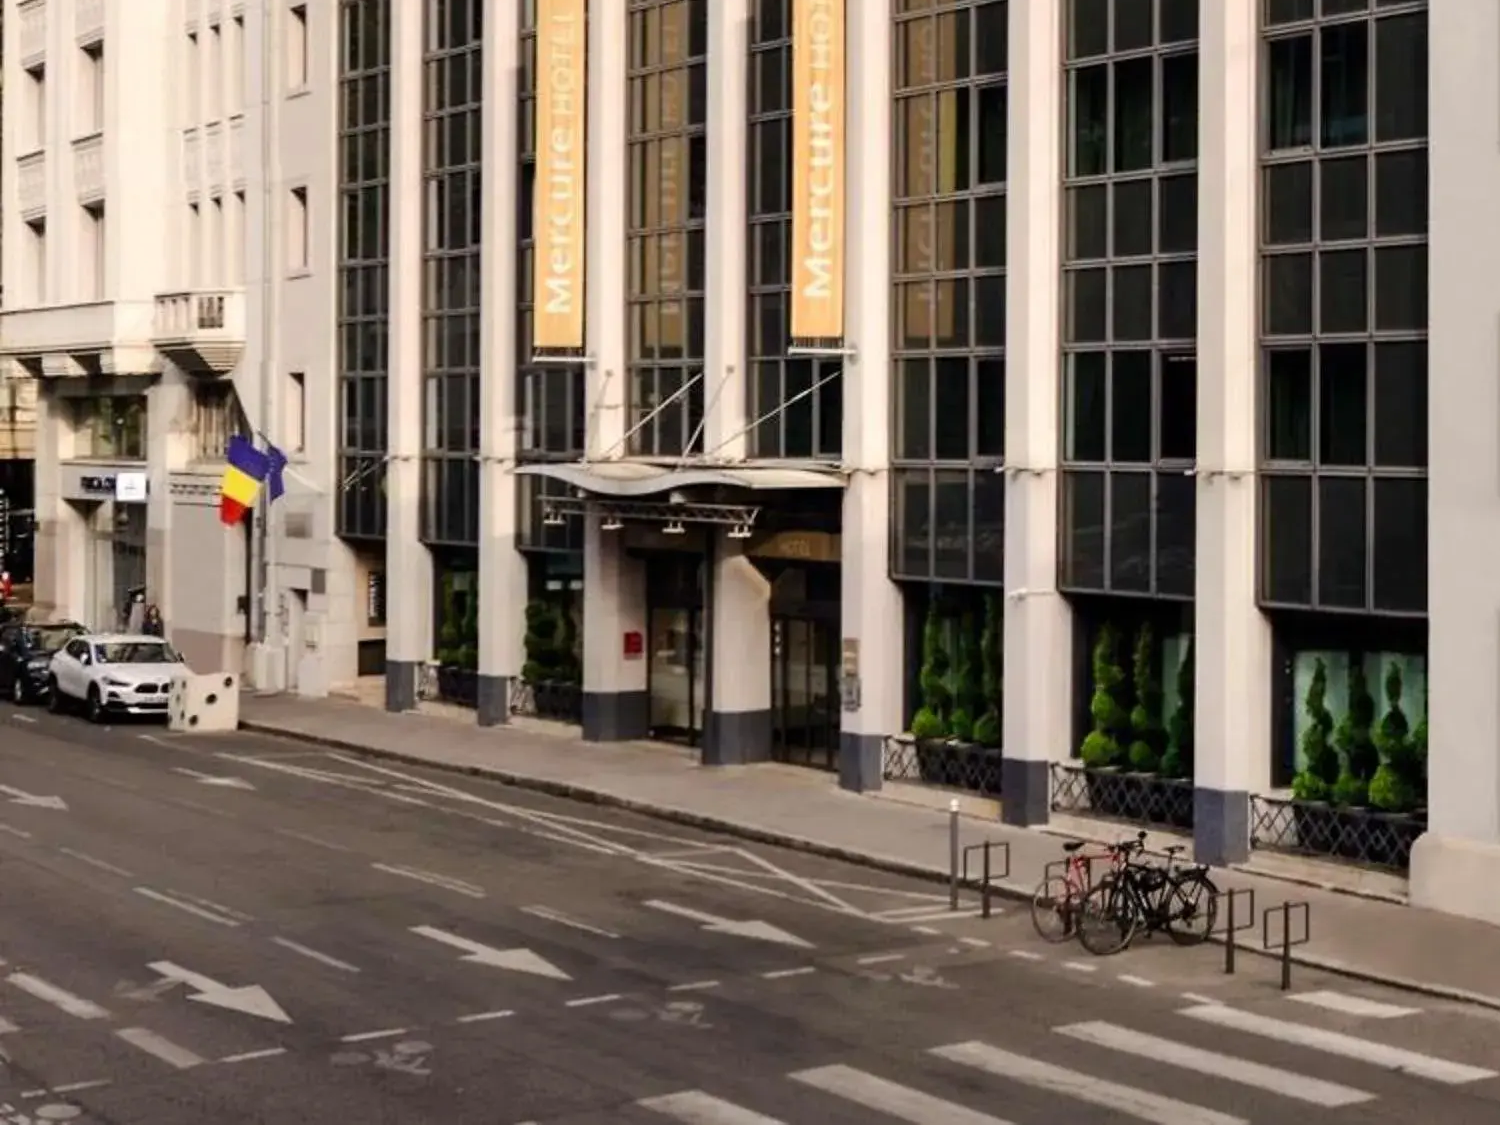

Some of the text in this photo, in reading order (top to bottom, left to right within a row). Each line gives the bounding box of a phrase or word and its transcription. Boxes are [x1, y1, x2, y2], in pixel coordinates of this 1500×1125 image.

[544, 14, 576, 314] Mercure HOTEL
[802, 82, 834, 298] Mercure
